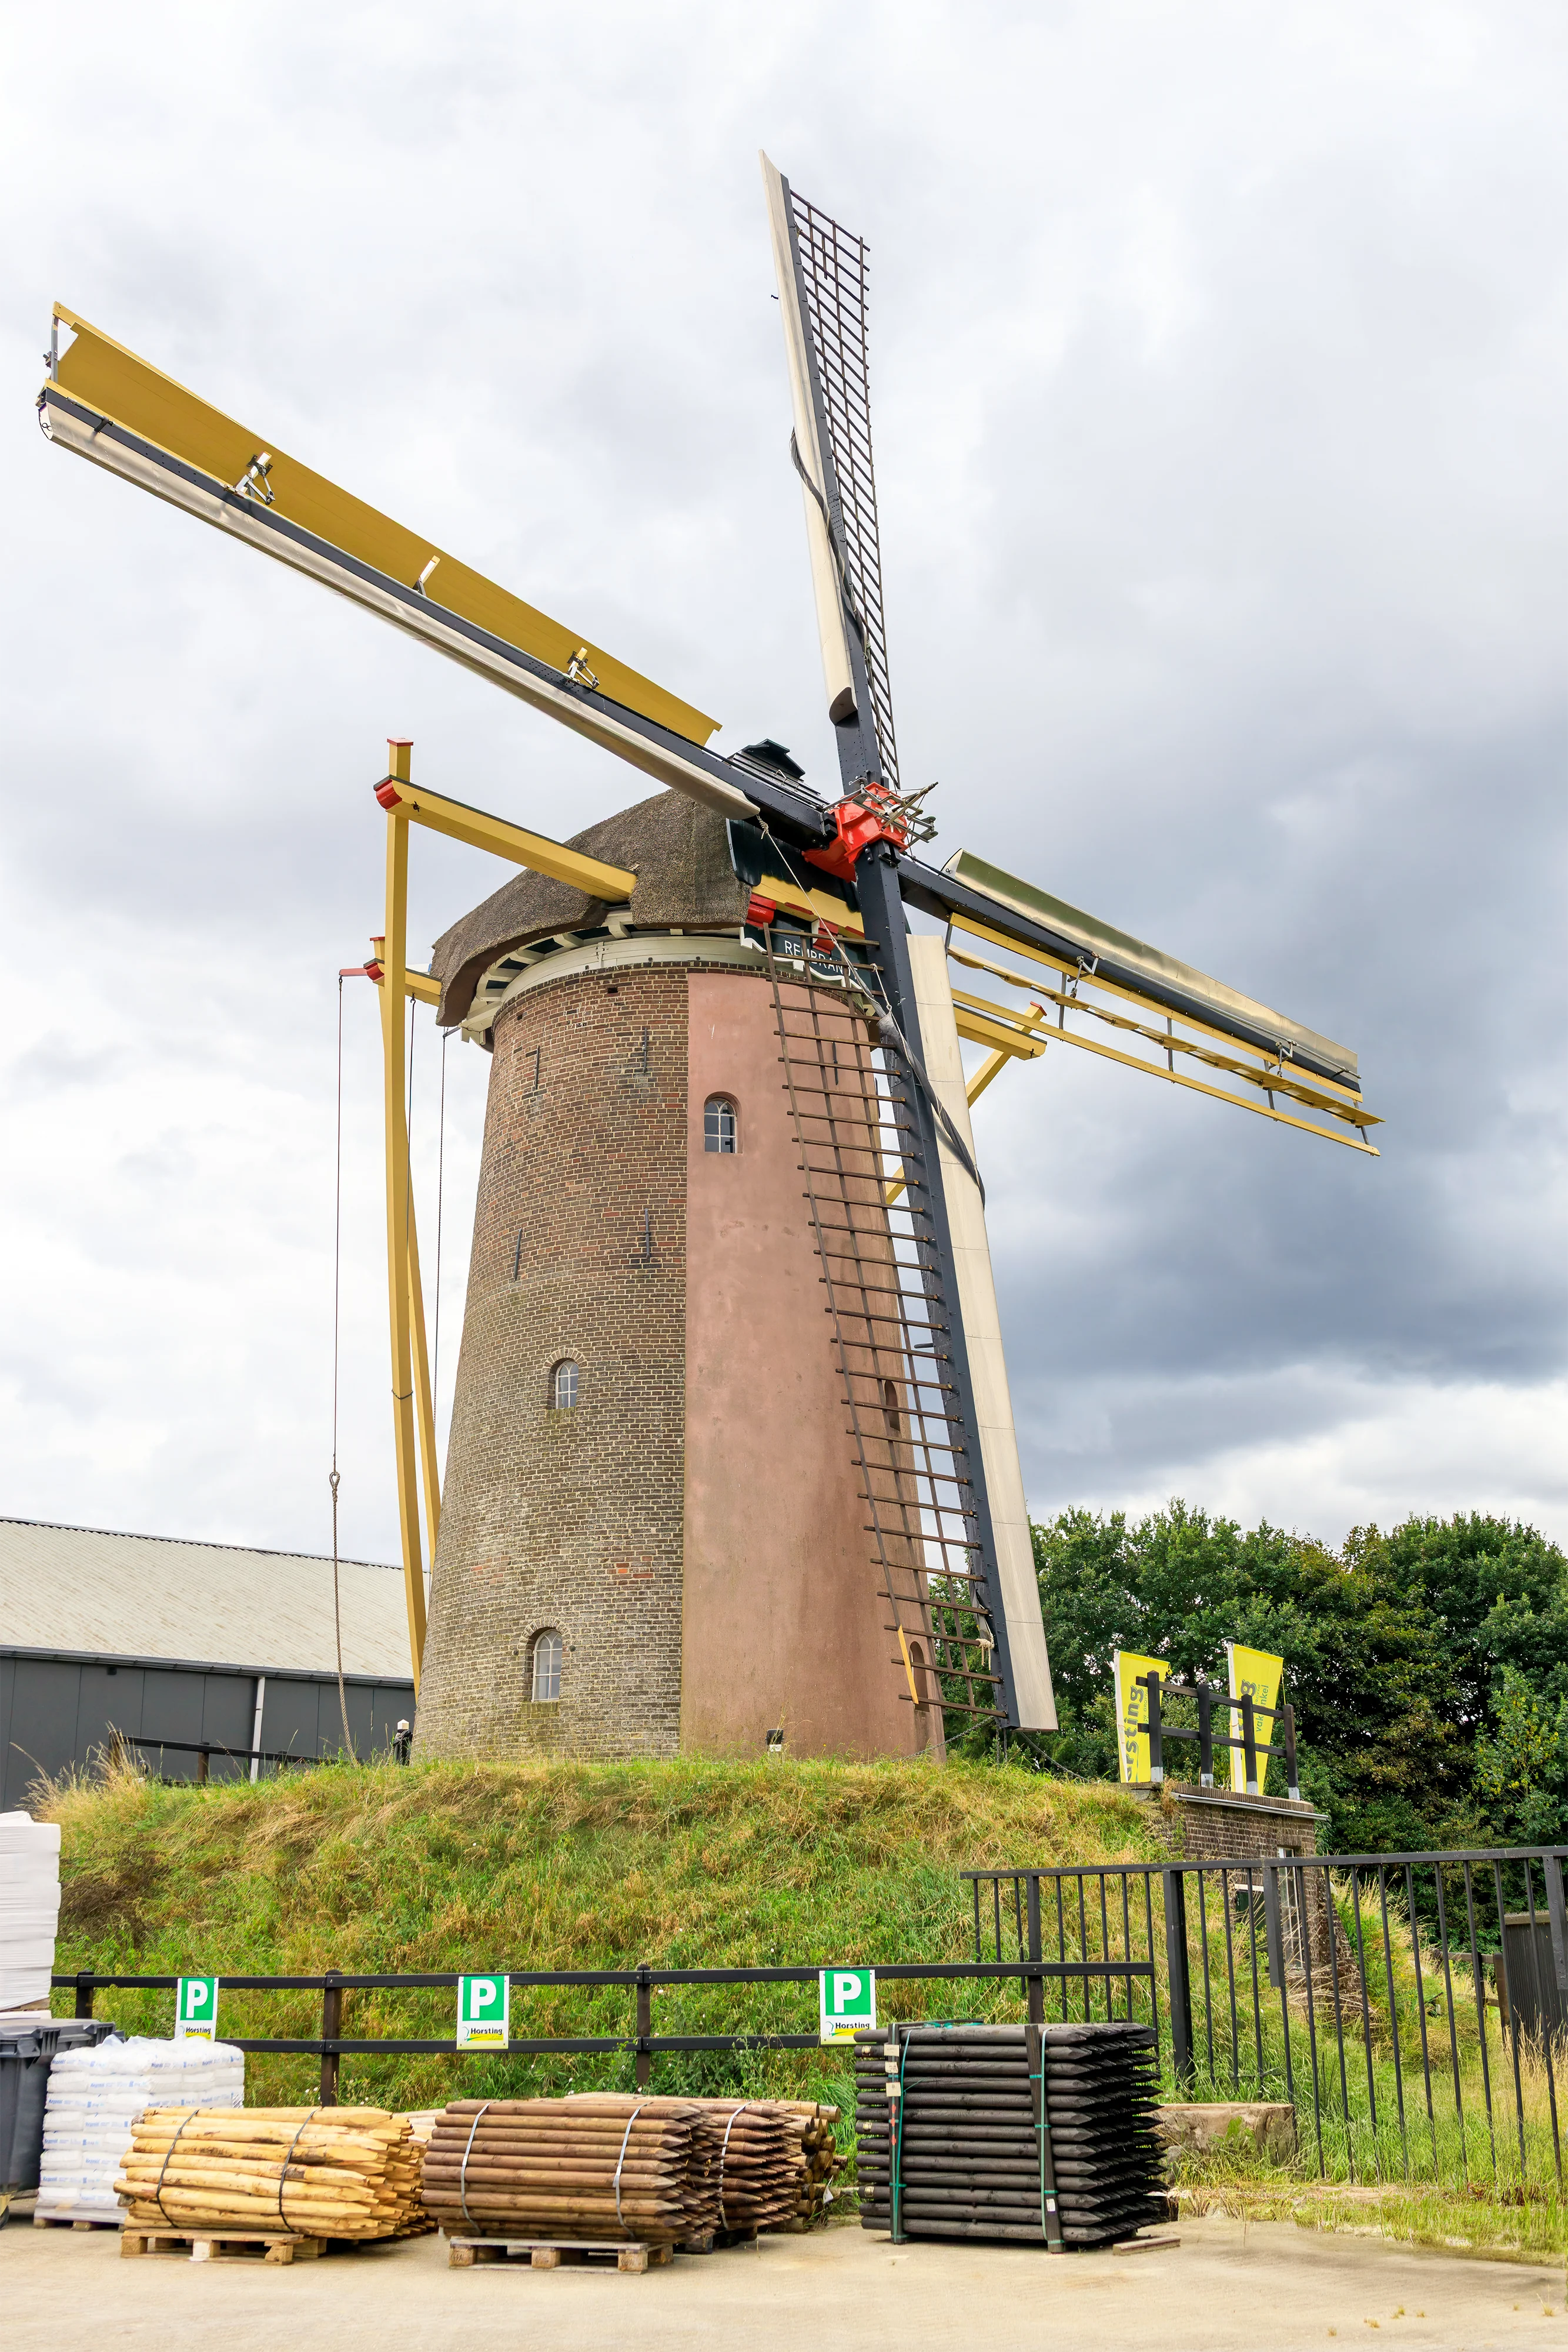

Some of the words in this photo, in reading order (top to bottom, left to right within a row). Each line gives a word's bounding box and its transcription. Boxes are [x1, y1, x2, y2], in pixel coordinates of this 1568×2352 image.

[1255, 1684, 1269, 1732] vaknkel
[186, 1980, 209, 2019] P
[470, 1979, 497, 2019] P
[833, 1973, 862, 2013] P
[185, 2026, 212, 2034] Horsting
[470, 2027, 503, 2035] Horsting
